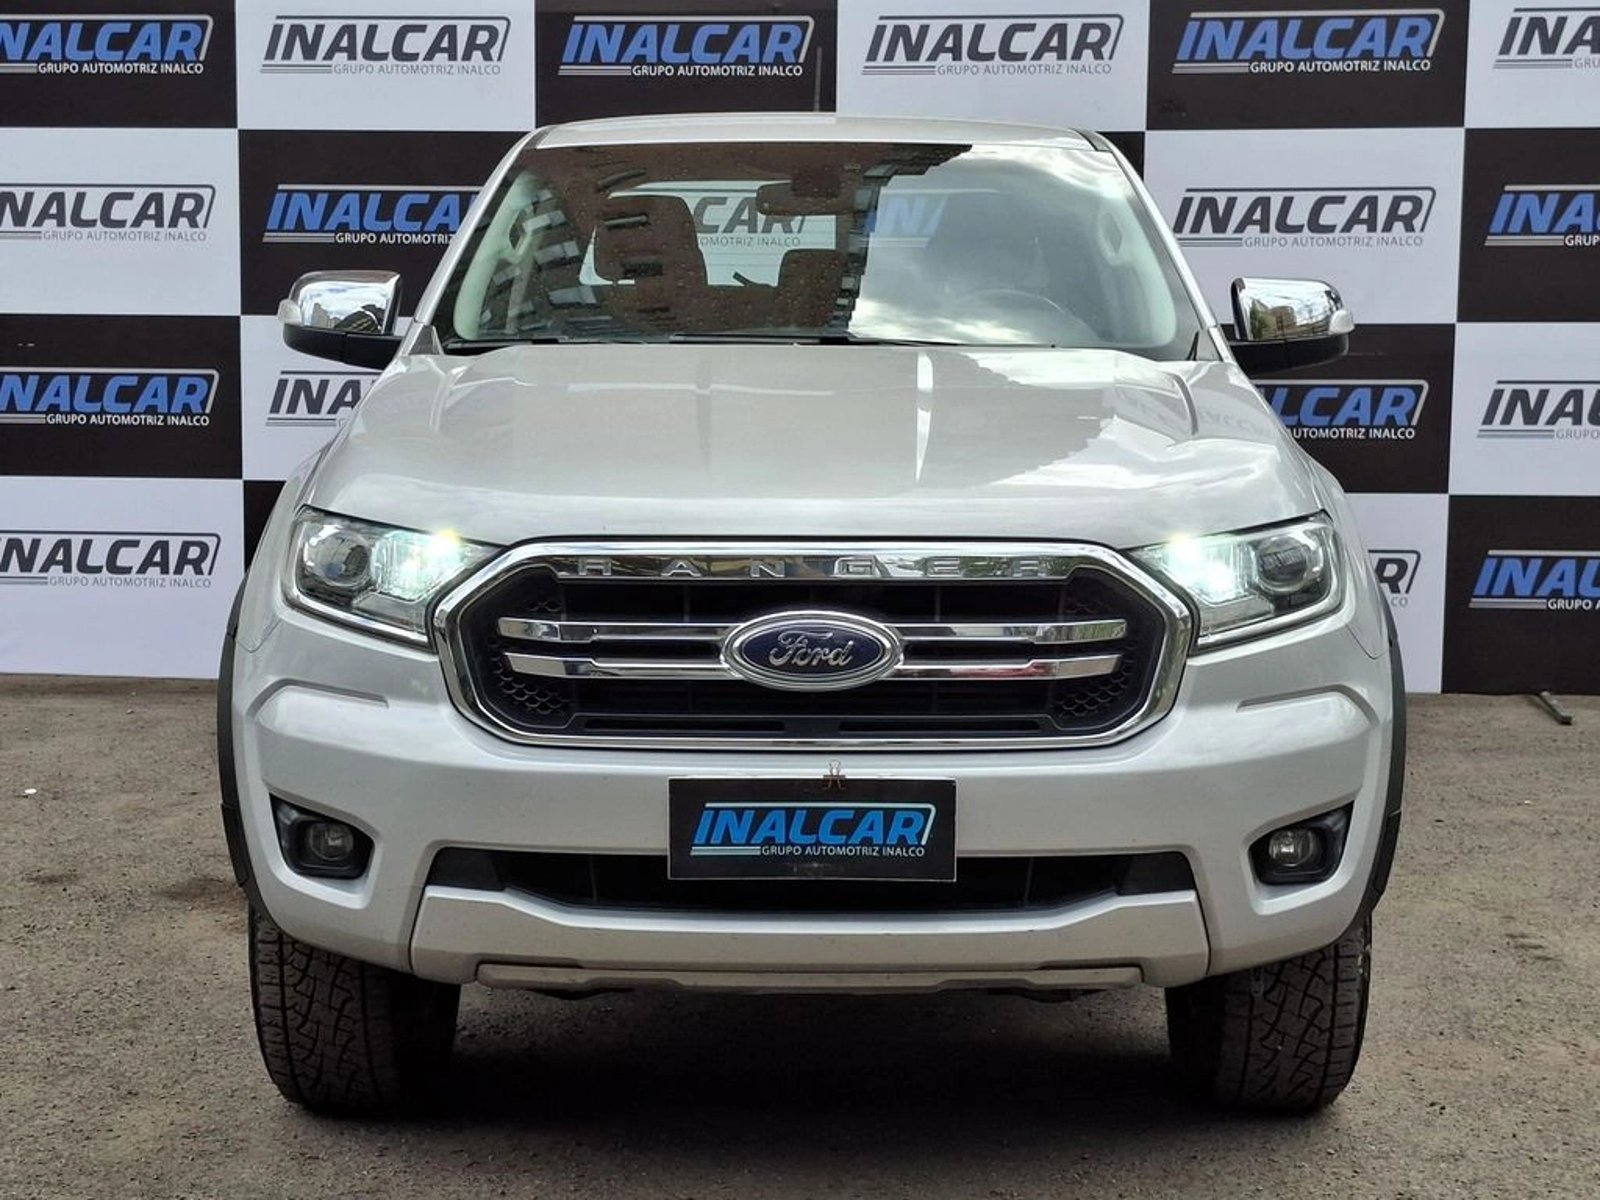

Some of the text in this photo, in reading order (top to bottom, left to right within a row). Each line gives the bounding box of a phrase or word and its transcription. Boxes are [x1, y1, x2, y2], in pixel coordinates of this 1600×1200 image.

[263, 23, 500, 62] INALCAR
[561, 24, 802, 64] INALCAR
[865, 22, 1112, 62] INALCAR
[1176, 17, 1432, 61] INALCAR
[38, 63, 204, 74] GRUPO AUTOMOTRIZ INALCO
[333, 64, 501, 76] GRUPO AUTOMOTRIZ INALCO
[632, 65, 803, 77] GRUPO AUTOMOTRIZ INALCO
[937, 63, 1112, 76] GRUPO AUTOMOTRIZ INALCO
[1250, 59, 1431, 73] GRUPO AUTOMOTRIZ INALCO
[0, 191, 205, 229] NALCAR
[266, 192, 478, 232] INALCA
[1172, 194, 1424, 234] INALCAR
[43, 230, 207, 242] GRUPO AUTOMOTRIZ INALCO
[335, 233, 376, 244] GRUPO
[757, 236, 801, 248] INALCO
[1244, 235, 1424, 248] GRUPO AUTOMOTRIZ INALCO
[0, 375, 209, 413] NALCAR
[46, 414, 210, 426] GRUPO AUTOMOTRIZ INALCO
[1369, 427, 1416, 439] INALCO
[577, 554, 1049, 577] RANGER
[50, 576, 212, 588] GRUPO AUTOMOTRIZ INALCO
[1548, 599, 1592, 610] GRUPO
[768, 630, 853, 667] Ford
[693, 809, 924, 845] INALCAR
[761, 846, 925, 857] GRUPO AUTOMOTRIZ INALCO
